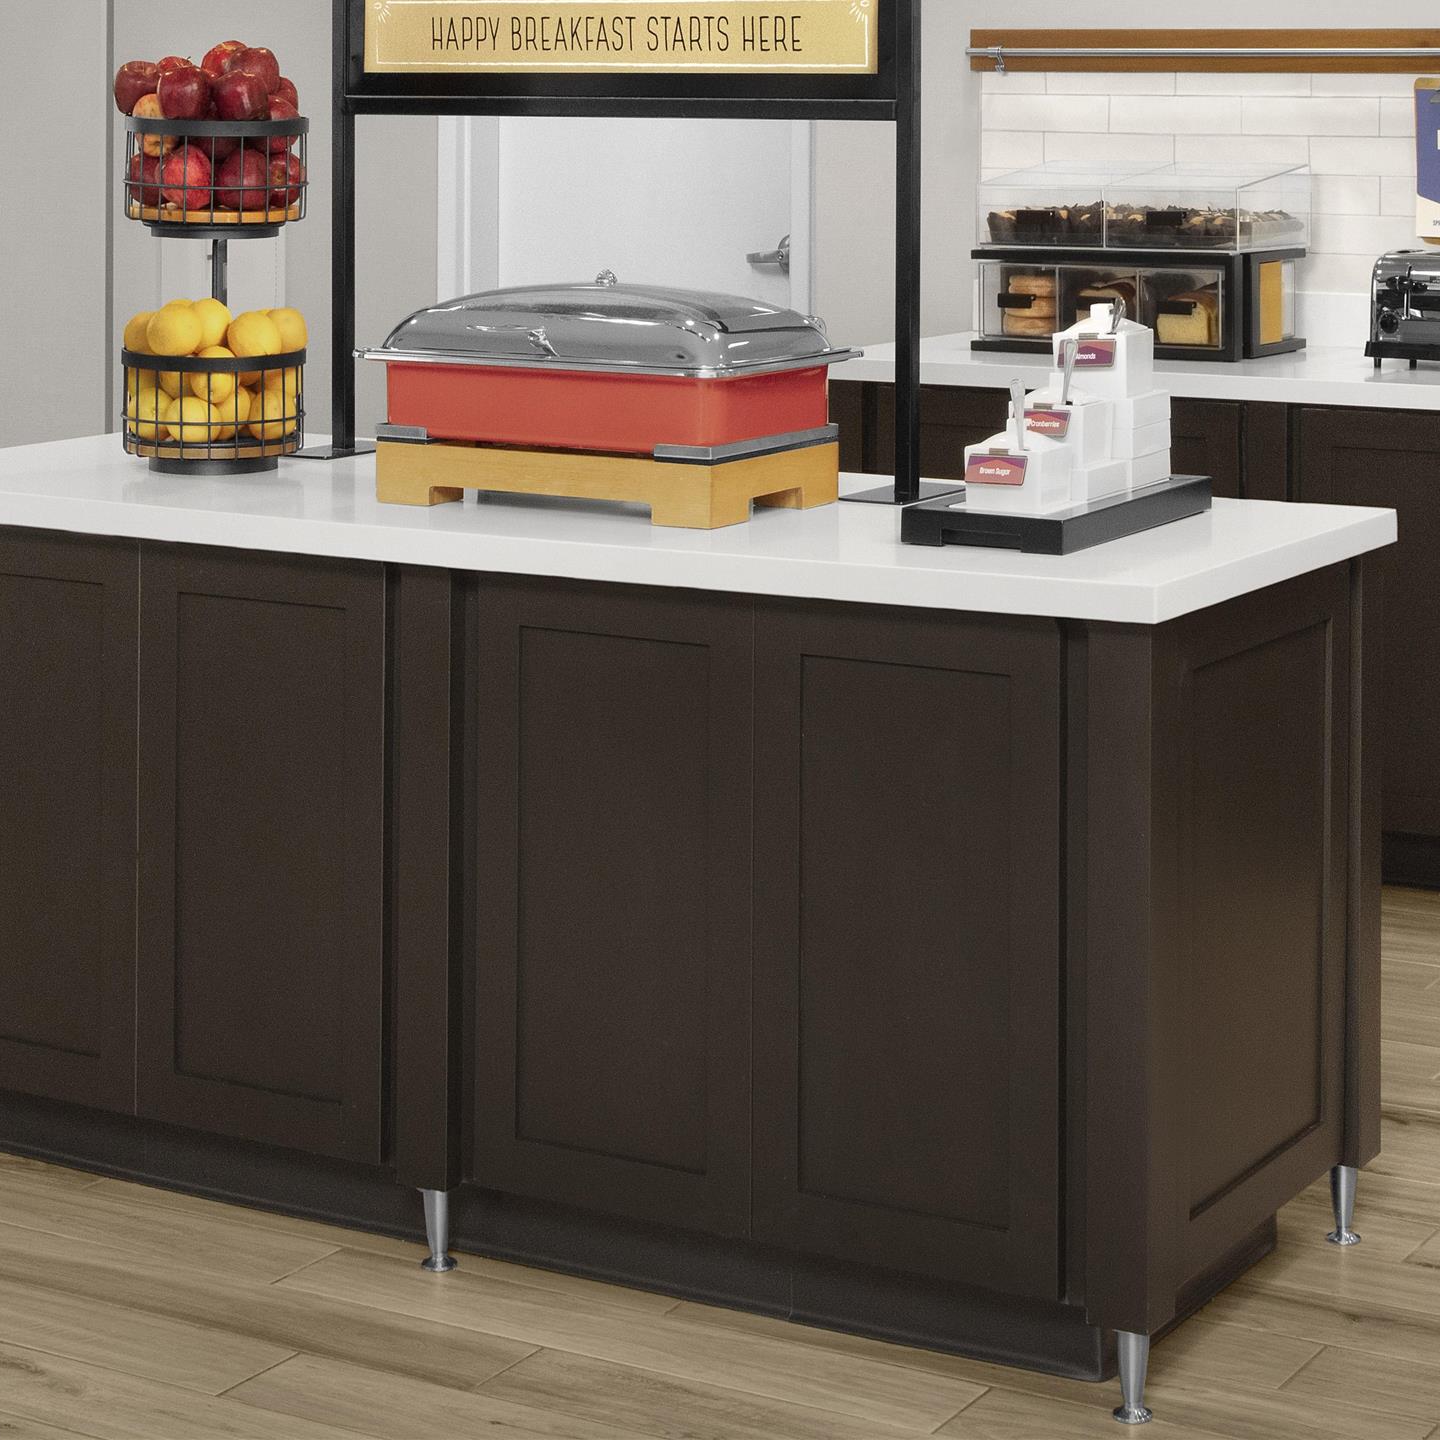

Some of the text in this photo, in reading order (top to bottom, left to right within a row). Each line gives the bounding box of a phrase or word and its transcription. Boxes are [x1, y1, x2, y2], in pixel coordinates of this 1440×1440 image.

[431, 15, 803, 52] HAPPY BREAKFAST STARTS HERE
